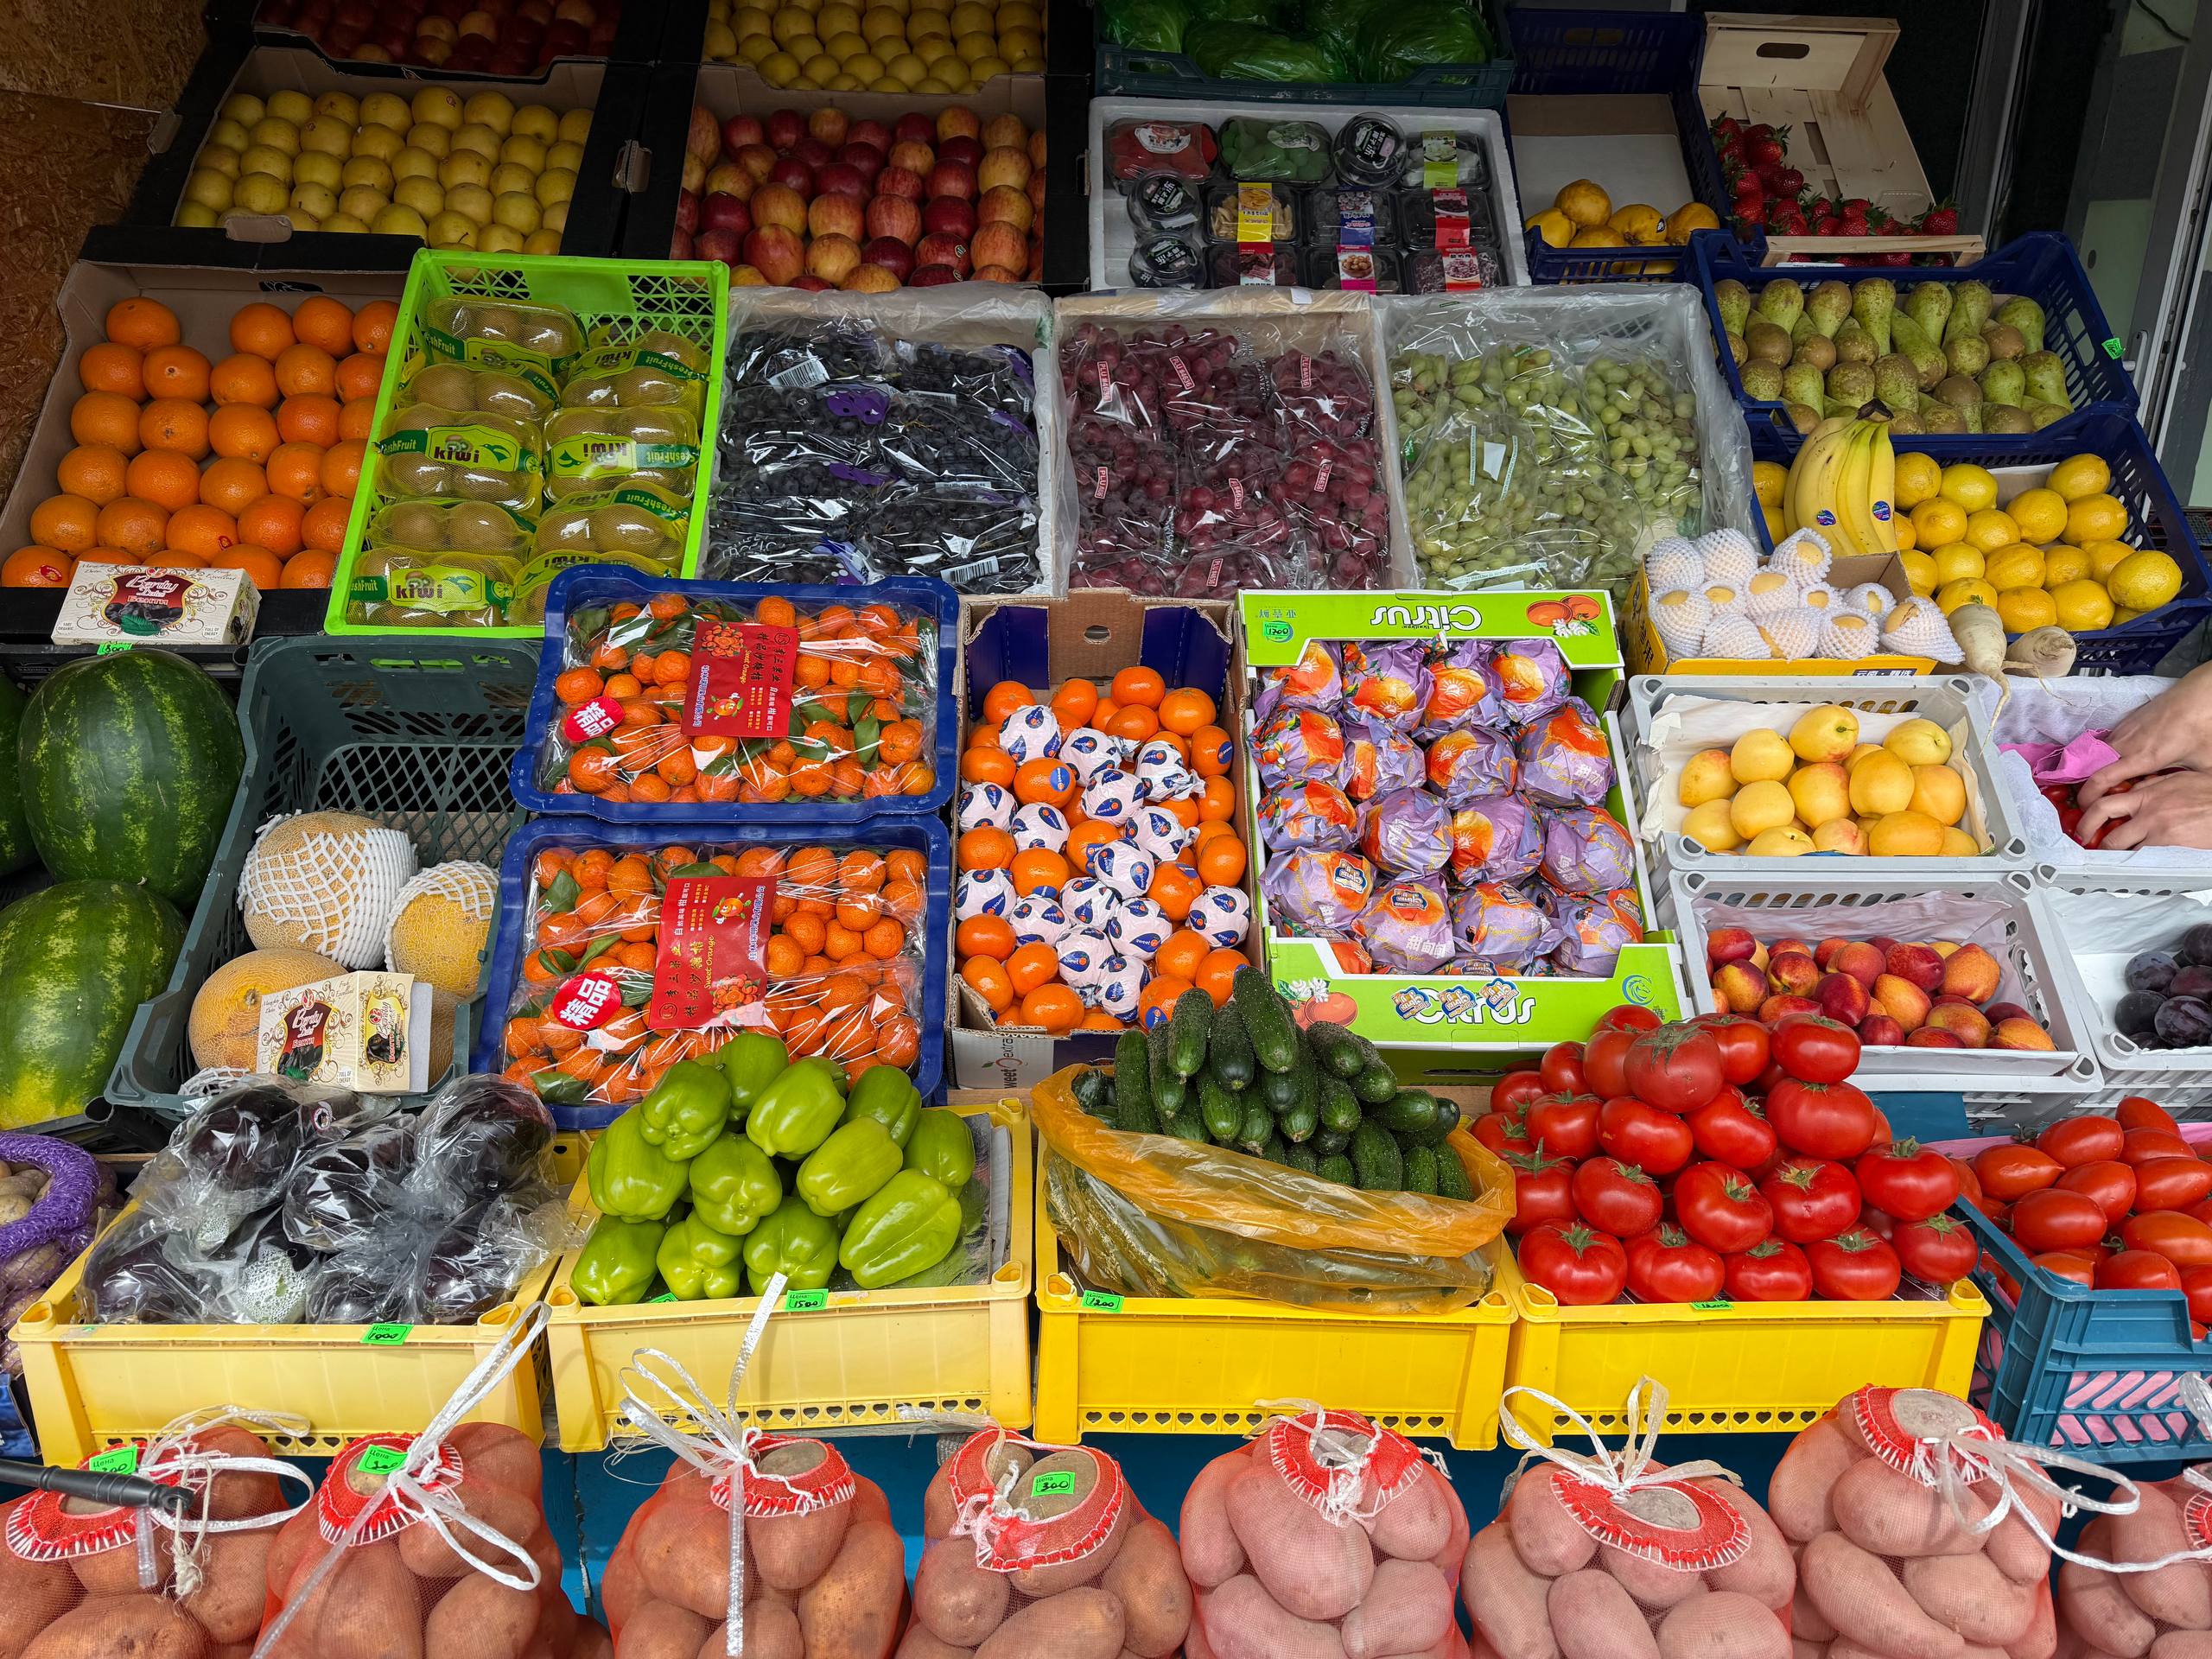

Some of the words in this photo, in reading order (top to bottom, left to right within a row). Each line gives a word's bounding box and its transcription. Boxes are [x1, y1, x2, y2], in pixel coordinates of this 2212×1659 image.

[434, 446, 480, 463] kiwi
[583, 442, 627, 458] kiwi
[396, 584, 443, 599] kiwi
[1370, 605, 1482, 631] Citrus
[573, 701, 616, 737] 精品
[705, 934, 715, 965] Orange
[703, 967, 713, 989] Sweet
[560, 978, 613, 1026] 精品
[1001, 1038, 1015, 1058] extra
[1000, 1068, 1017, 1090] weet
[93, 1458, 115, 1467] Цена
[370, 1450, 390, 1459] Цена
